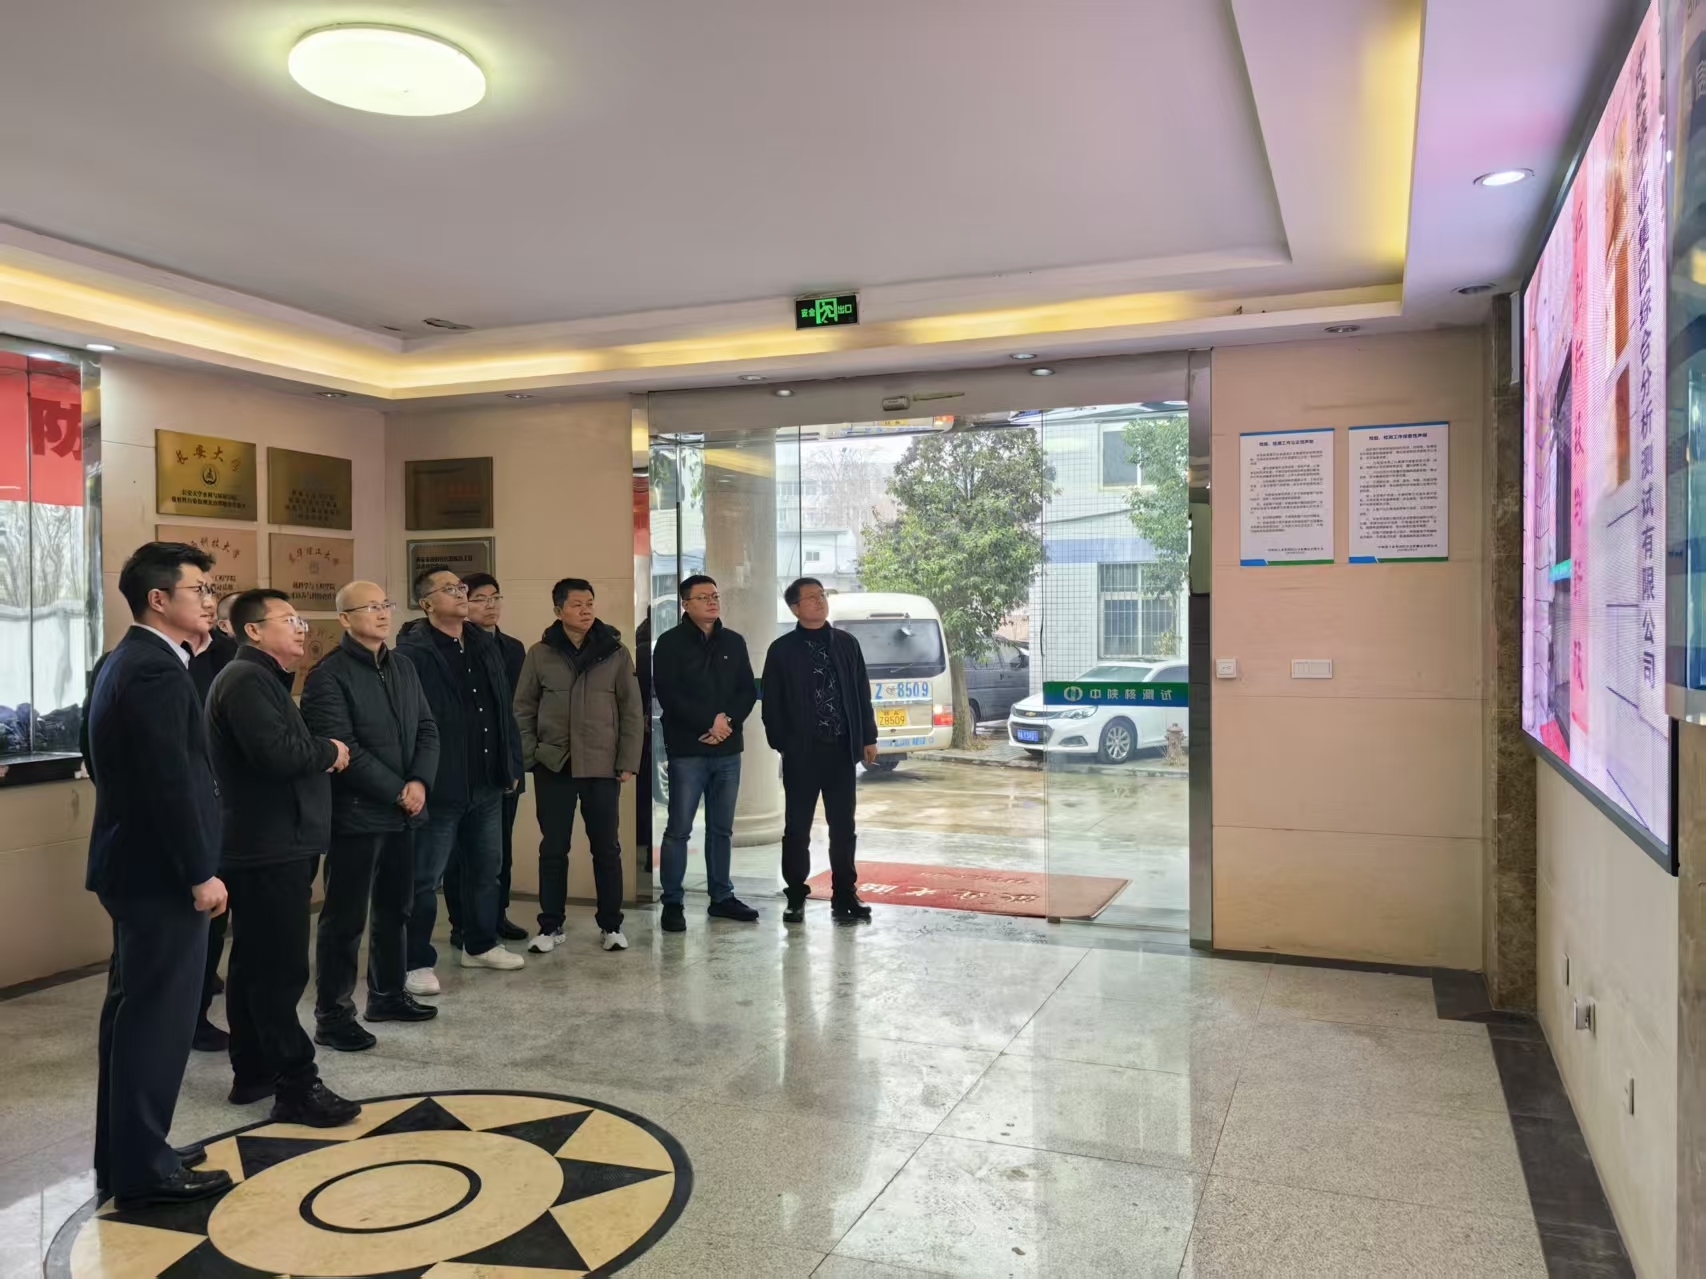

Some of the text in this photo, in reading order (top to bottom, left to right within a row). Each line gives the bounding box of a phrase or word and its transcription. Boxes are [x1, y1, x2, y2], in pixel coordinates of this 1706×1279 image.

[838, 304, 853, 315] 出口
[897, 681, 929, 698] 8509
[1089, 688, 1173, 701] 中陕核测试
